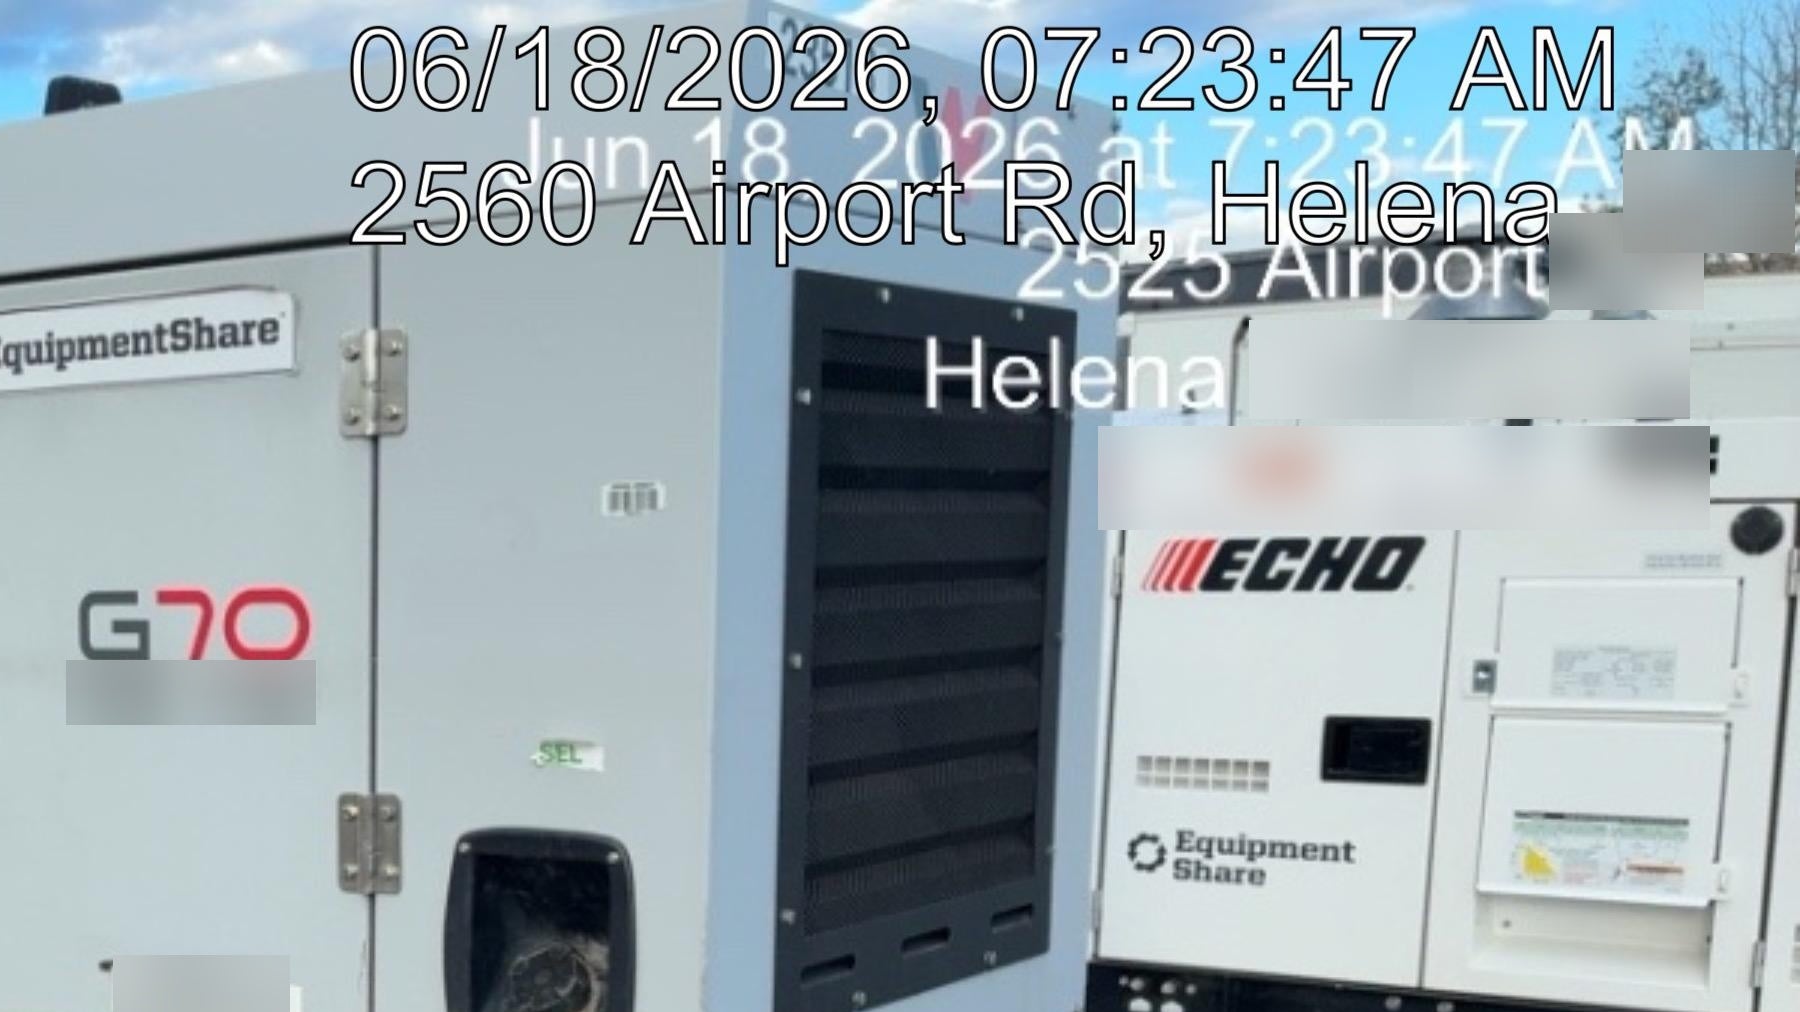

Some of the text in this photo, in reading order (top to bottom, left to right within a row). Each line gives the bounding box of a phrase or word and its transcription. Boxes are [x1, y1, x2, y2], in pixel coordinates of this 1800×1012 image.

[1198, 535, 1426, 592] ECHO
[78, 587, 312, 660] G70
[1175, 829, 1357, 864] Equipment
[1173, 857, 1267, 886] Share
